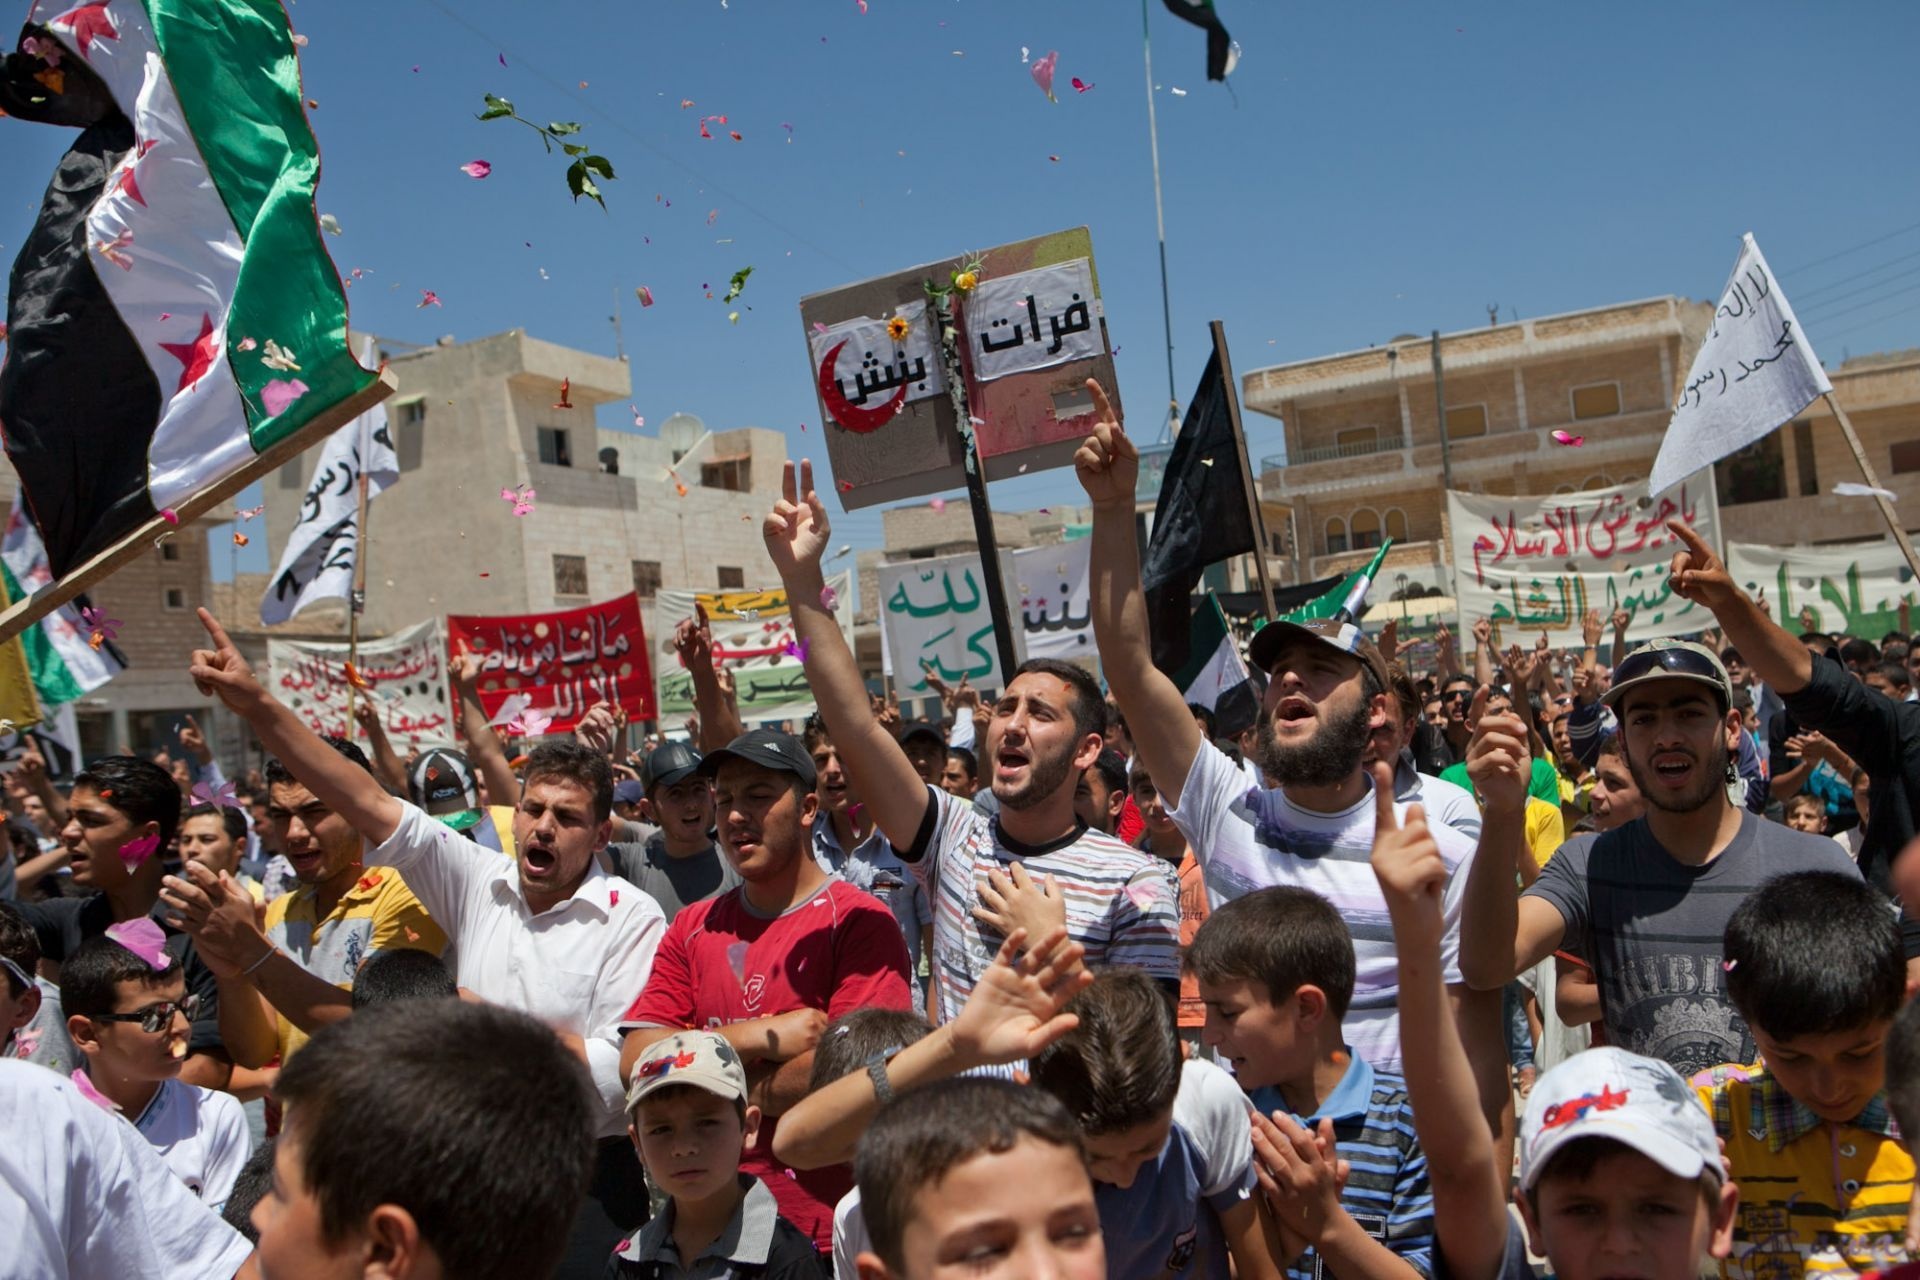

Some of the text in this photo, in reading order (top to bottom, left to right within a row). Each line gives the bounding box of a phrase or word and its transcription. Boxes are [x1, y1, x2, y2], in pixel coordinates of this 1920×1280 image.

[980, 292, 1091, 355] فرات
[1734, 318, 1795, 384] محمد
[834, 350, 926, 406] بنش
[1472, 505, 1581, 586] الاسلام
